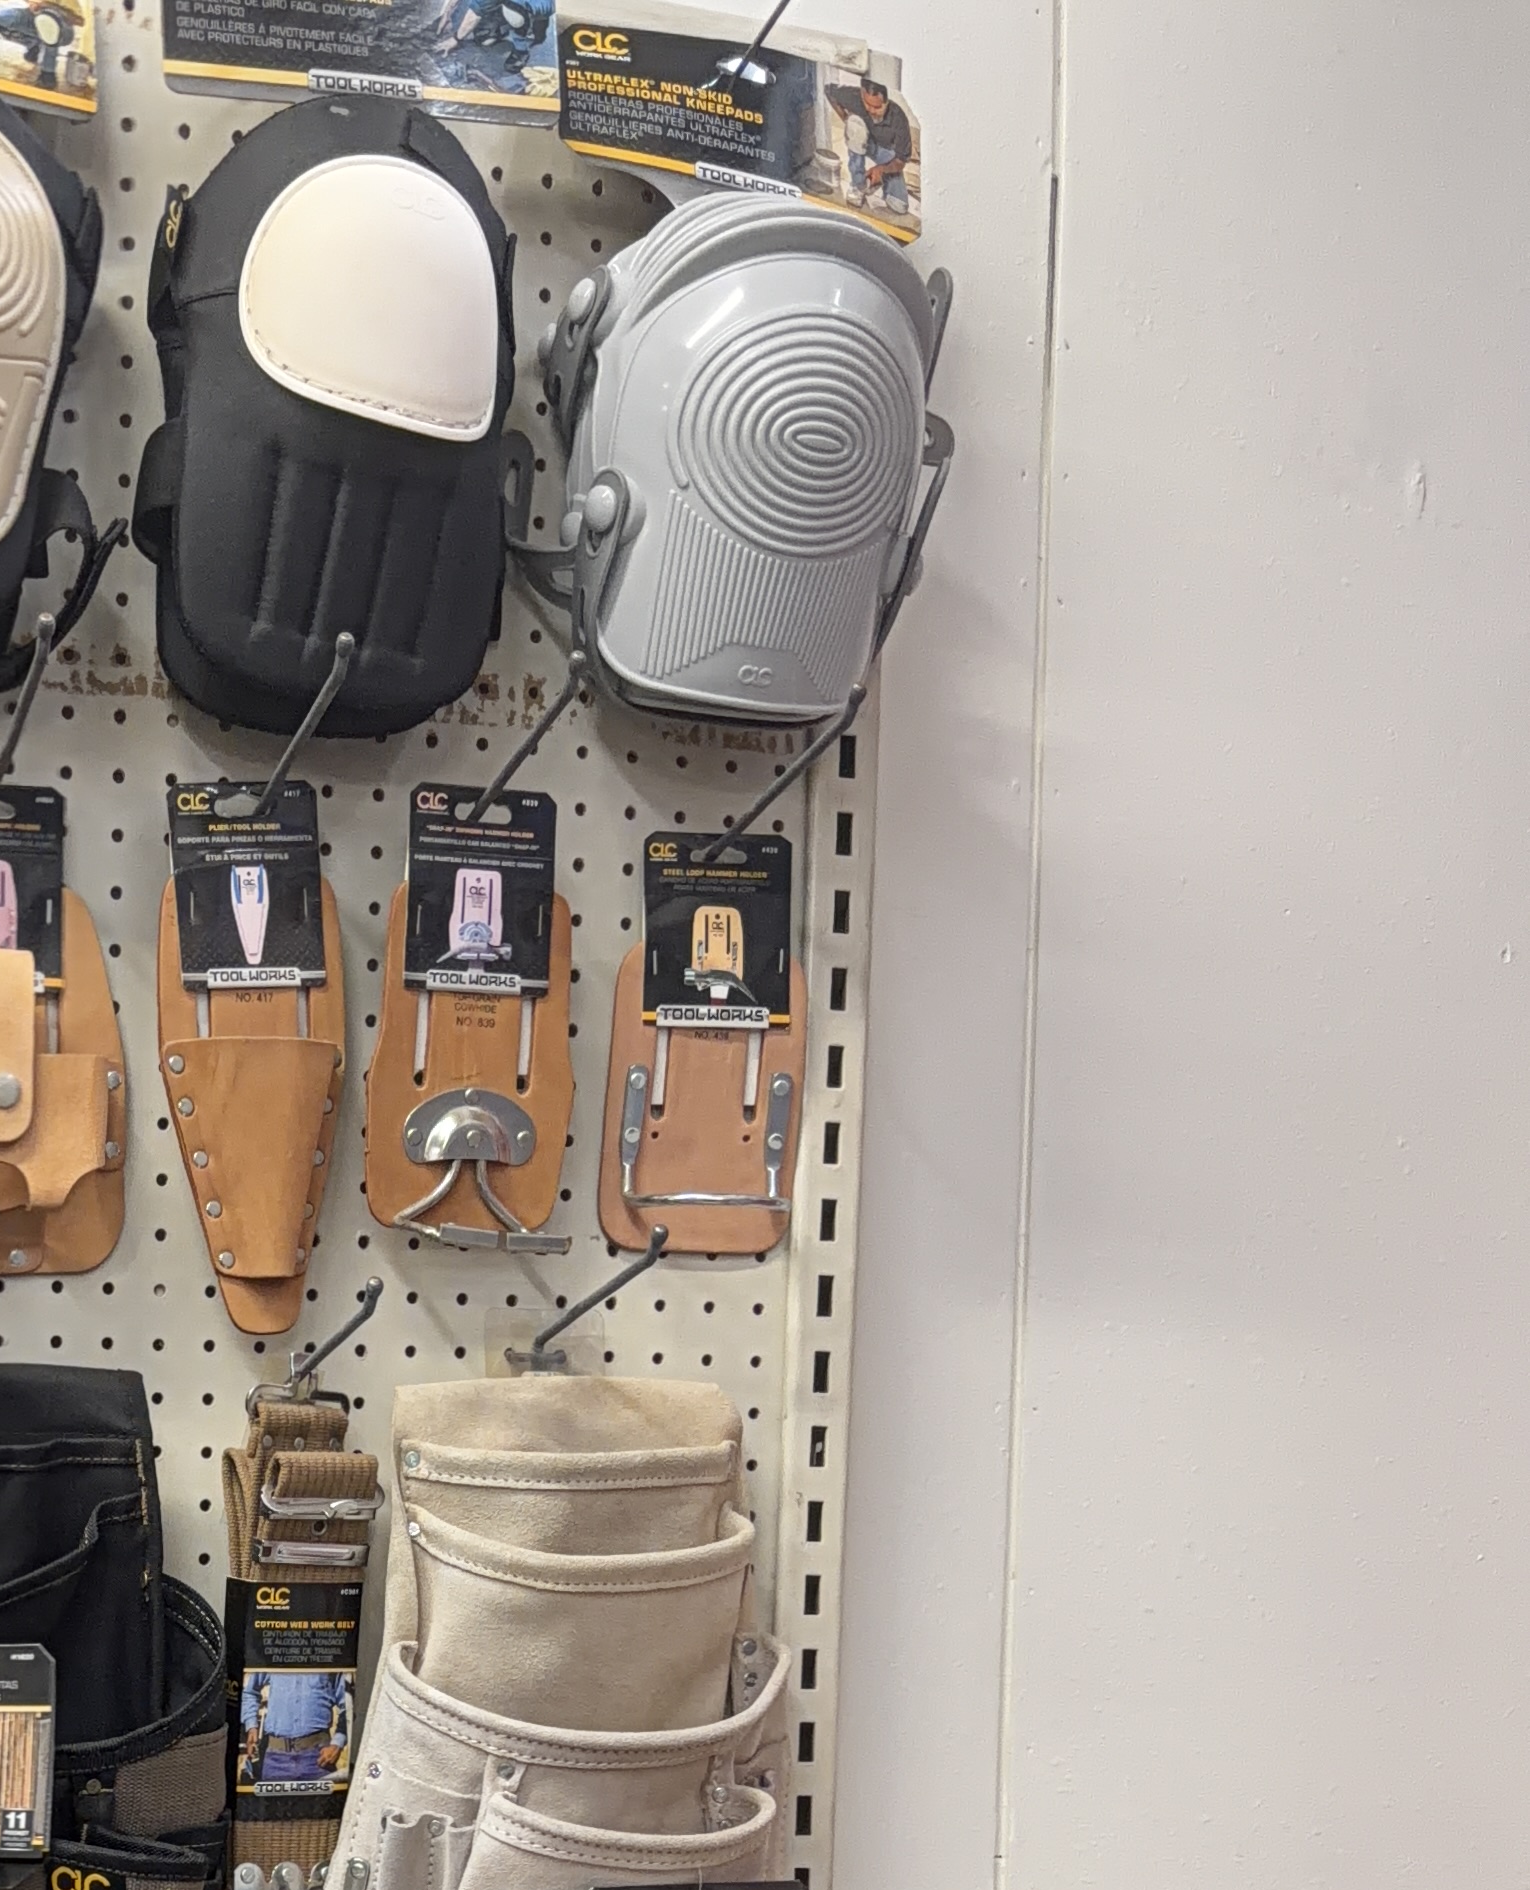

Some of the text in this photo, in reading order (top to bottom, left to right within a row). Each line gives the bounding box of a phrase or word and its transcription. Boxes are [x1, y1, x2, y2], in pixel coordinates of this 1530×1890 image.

[572, 29, 630, 54] CLC
[567, 79, 764, 124] PROFESSIONAL KNEEPADS
[568, 90, 743, 132] RODILLERAS PROFESIONALES
[177, 793, 210, 812] CLC
[416, 792, 449, 811] CLC
[649, 842, 678, 858] CLC
[256, 1587, 291, 1605] CLC
[5, 1812, 26, 1829] 11
